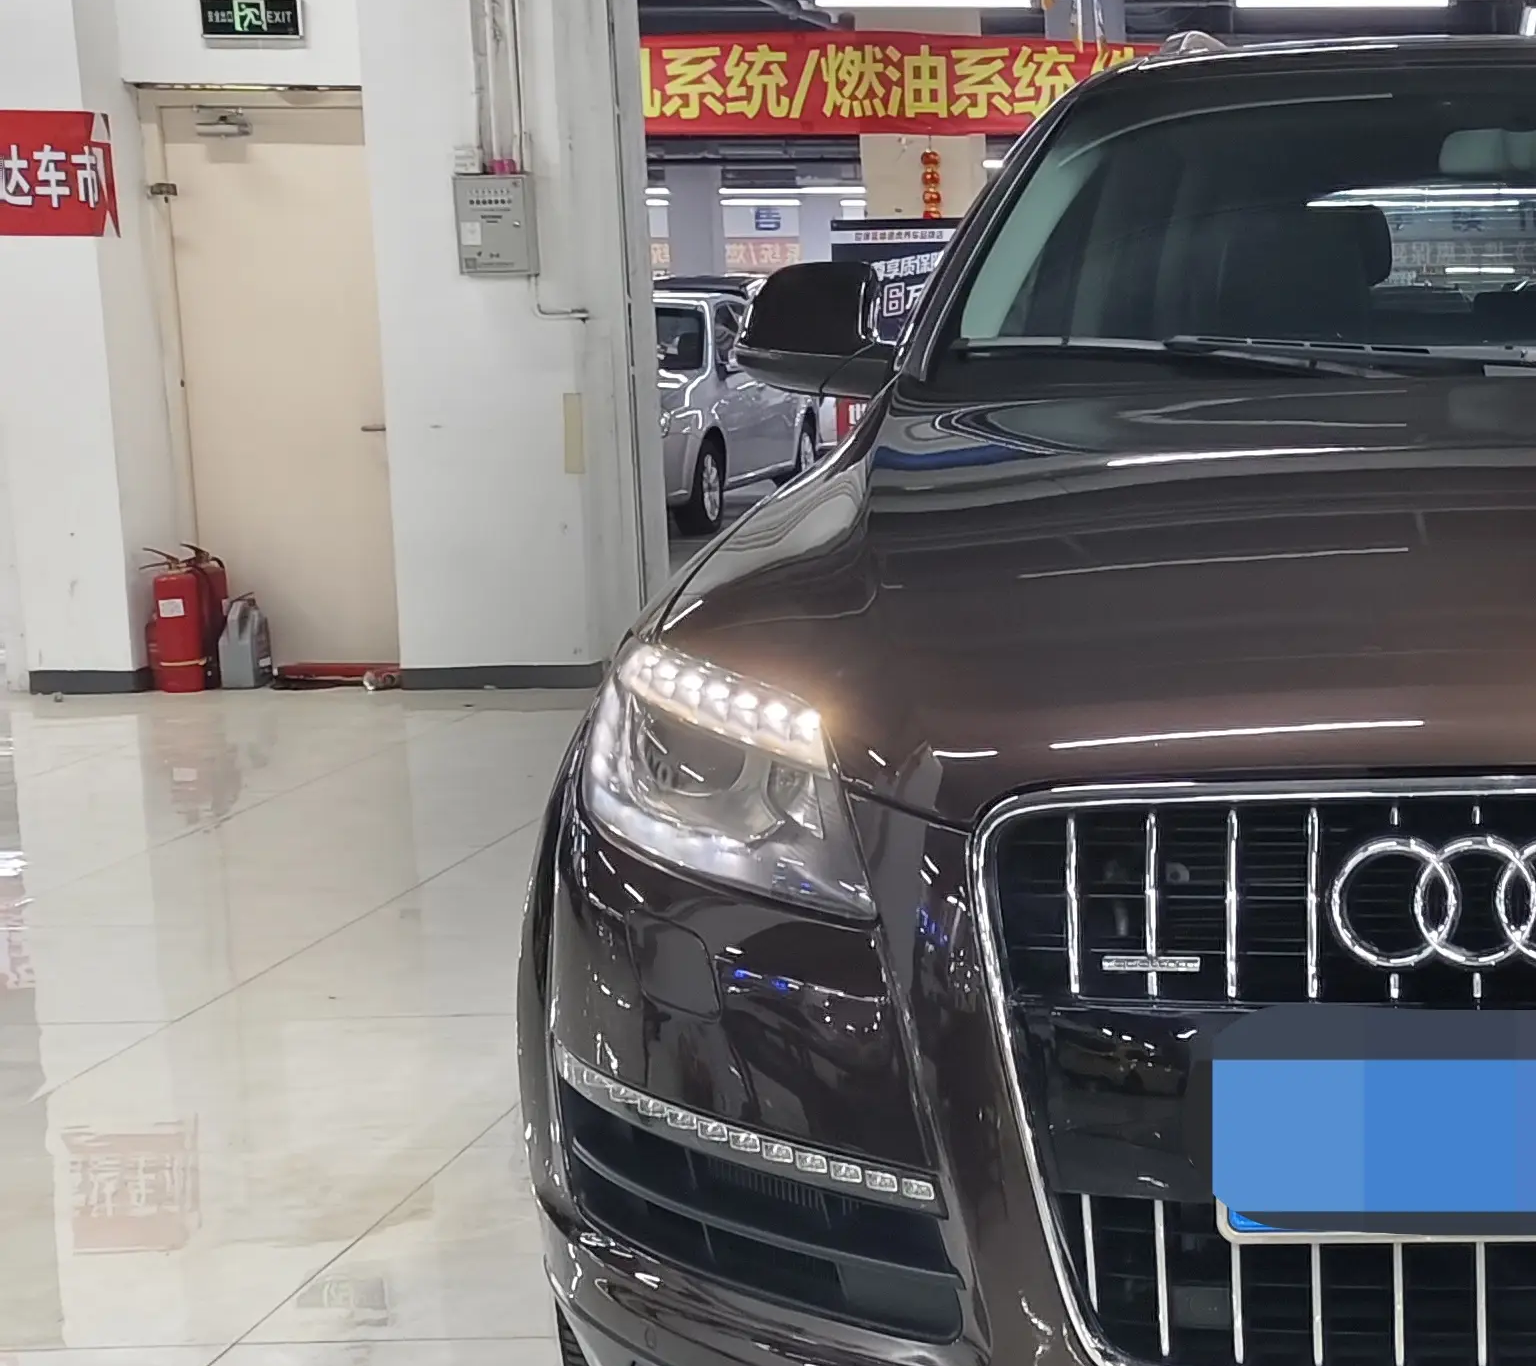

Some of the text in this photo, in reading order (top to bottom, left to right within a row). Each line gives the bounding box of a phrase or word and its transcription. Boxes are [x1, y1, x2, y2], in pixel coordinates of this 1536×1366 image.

[266, 10, 292, 24] EXIT
[640, 43, 1134, 120] 系统/燃油系统
[0, 144, 99, 208] 达车市
